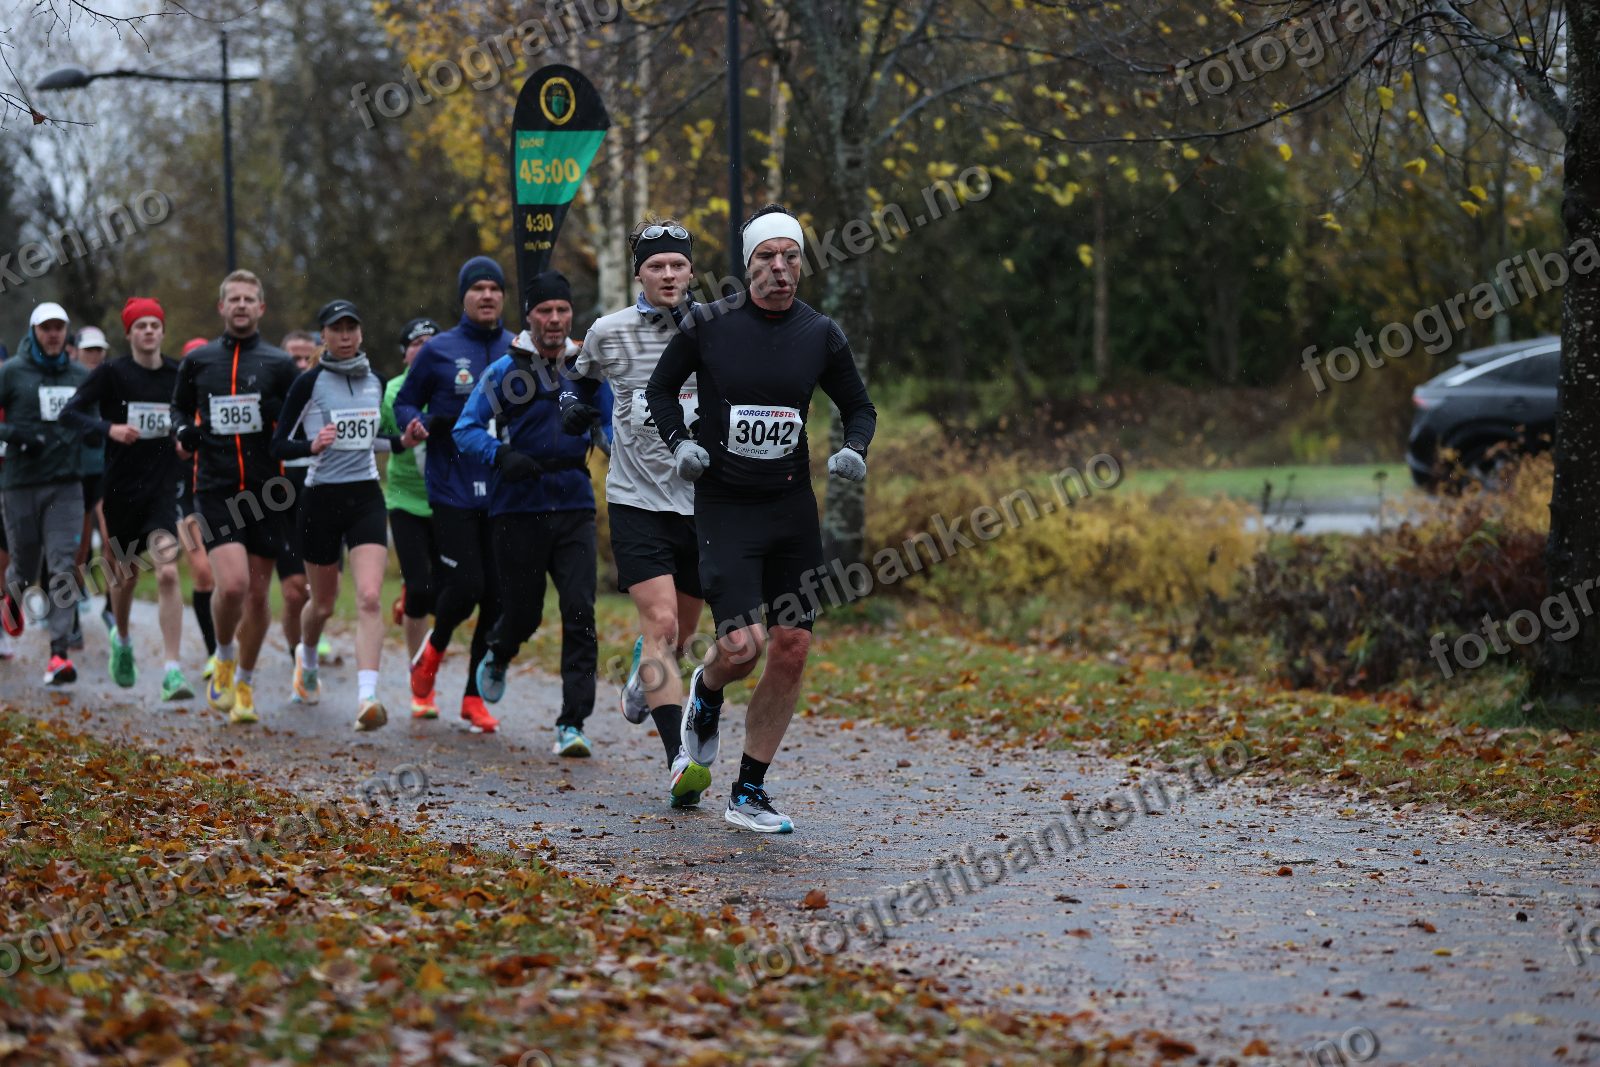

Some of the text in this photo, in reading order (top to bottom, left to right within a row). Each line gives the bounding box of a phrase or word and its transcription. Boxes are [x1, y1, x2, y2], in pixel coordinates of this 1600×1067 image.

[519, 157, 581, 185] 45:00
[525, 213, 554, 232] 4:30
[139, 413, 165, 431] 165
[219, 405, 252, 425] 385
[736, 409, 796, 419] NORGESTESTEN
[336, 418, 376, 439] 9361
[735, 419, 795, 446] 3042
[472, 480, 487, 497] TN
